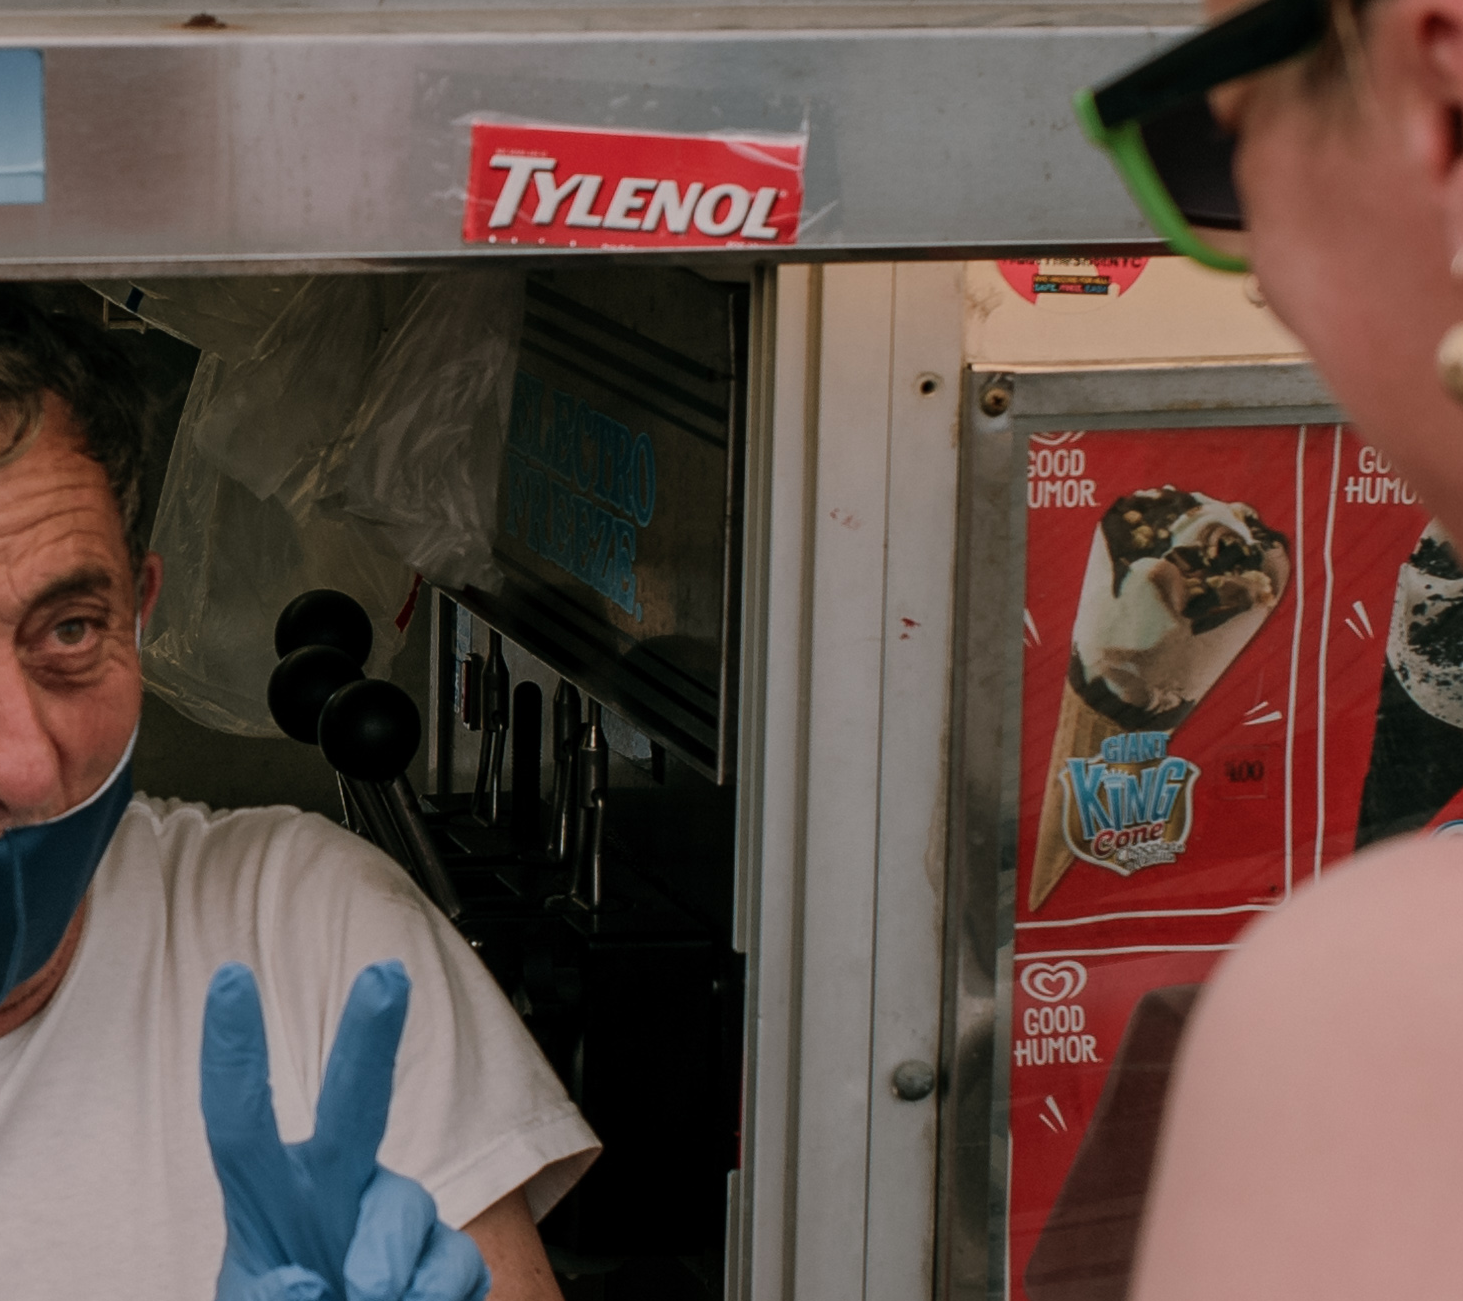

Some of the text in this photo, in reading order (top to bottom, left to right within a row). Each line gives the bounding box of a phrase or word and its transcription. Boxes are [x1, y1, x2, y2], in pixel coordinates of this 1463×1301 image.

[487, 154, 781, 241] TYLENOL
[1027, 478, 1098, 509] UMOR
[1100, 730, 1171, 764] GIANT
[1066, 755, 1189, 841] KING
[1023, 1004, 1086, 1037] GOOD
[1014, 1033, 1099, 1068] HUMOR
